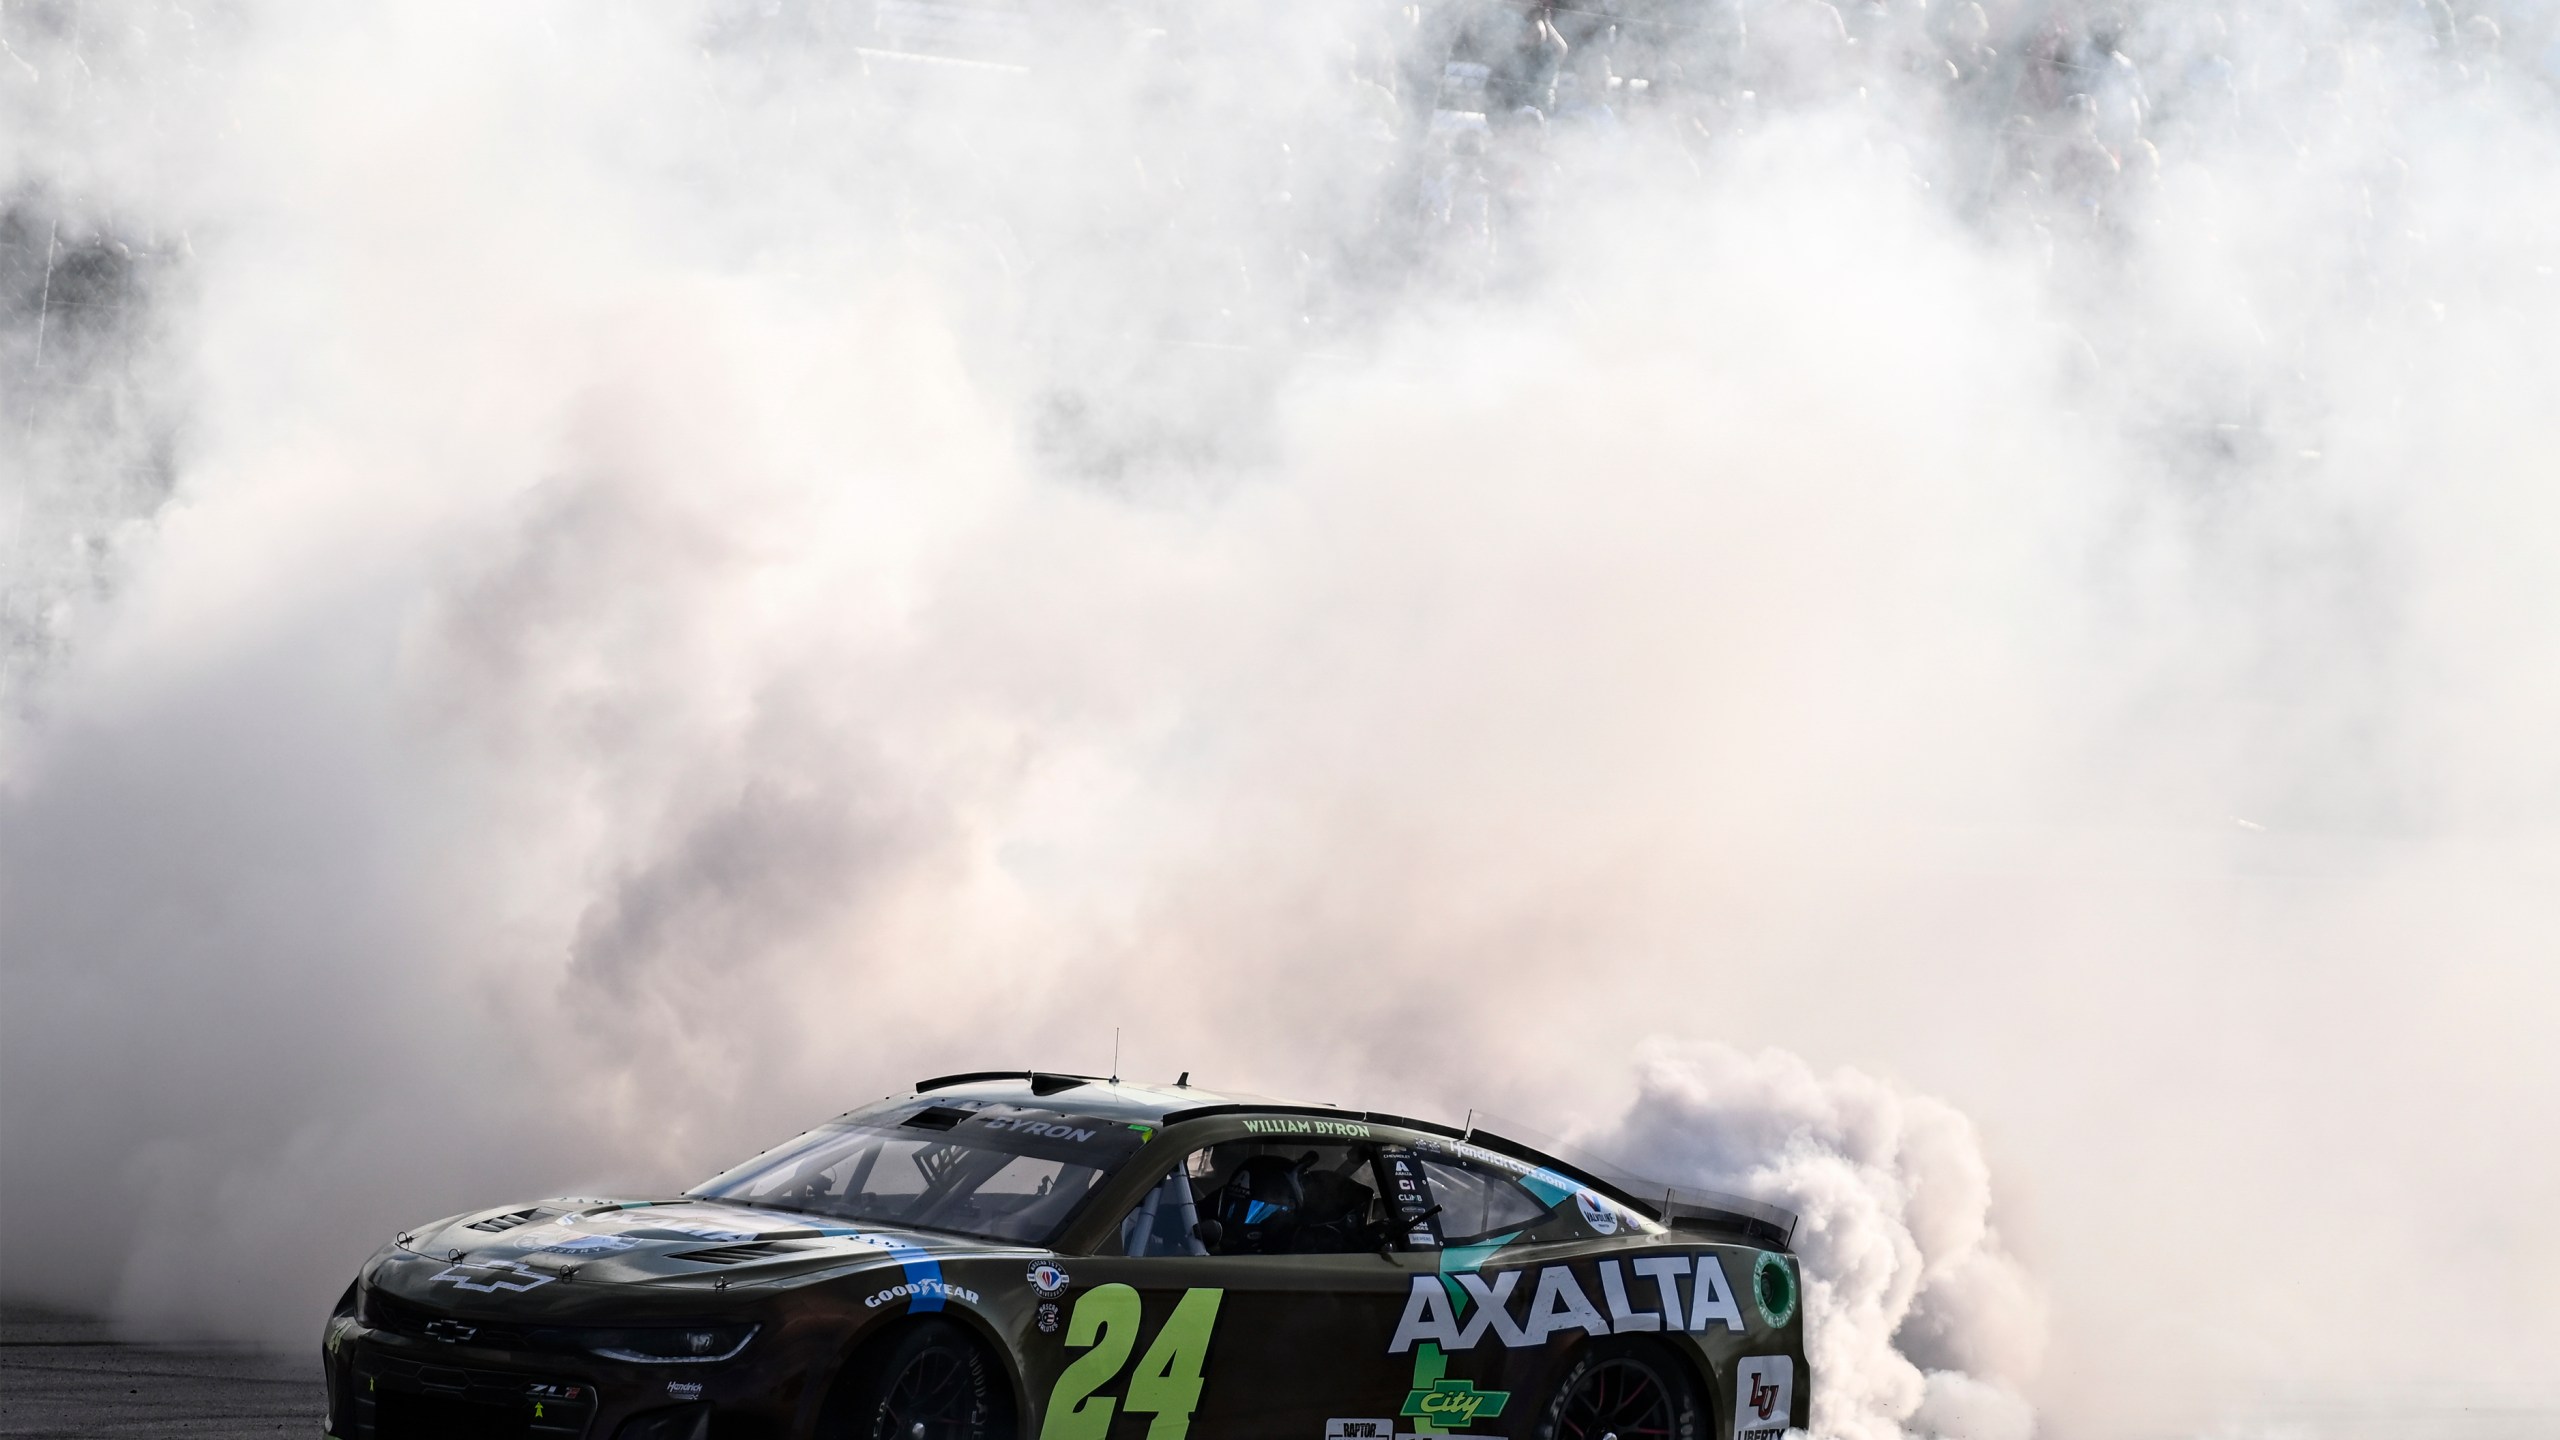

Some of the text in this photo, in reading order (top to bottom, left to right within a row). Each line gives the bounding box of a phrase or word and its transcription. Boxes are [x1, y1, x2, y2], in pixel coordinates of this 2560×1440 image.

[1243, 1120, 1370, 1137] WILLIAM BYRON
[1450, 1139, 1567, 1191] HendrickCars.com
[864, 1281, 980, 1308] GOODYEAR
[1388, 1255, 1746, 1354] AXALTA
[1039, 1283, 1225, 1440] 24
[1420, 1391, 1484, 1422] City
[1748, 1372, 1780, 1421] LU
[1343, 1422, 1377, 1438] RAPTOR
